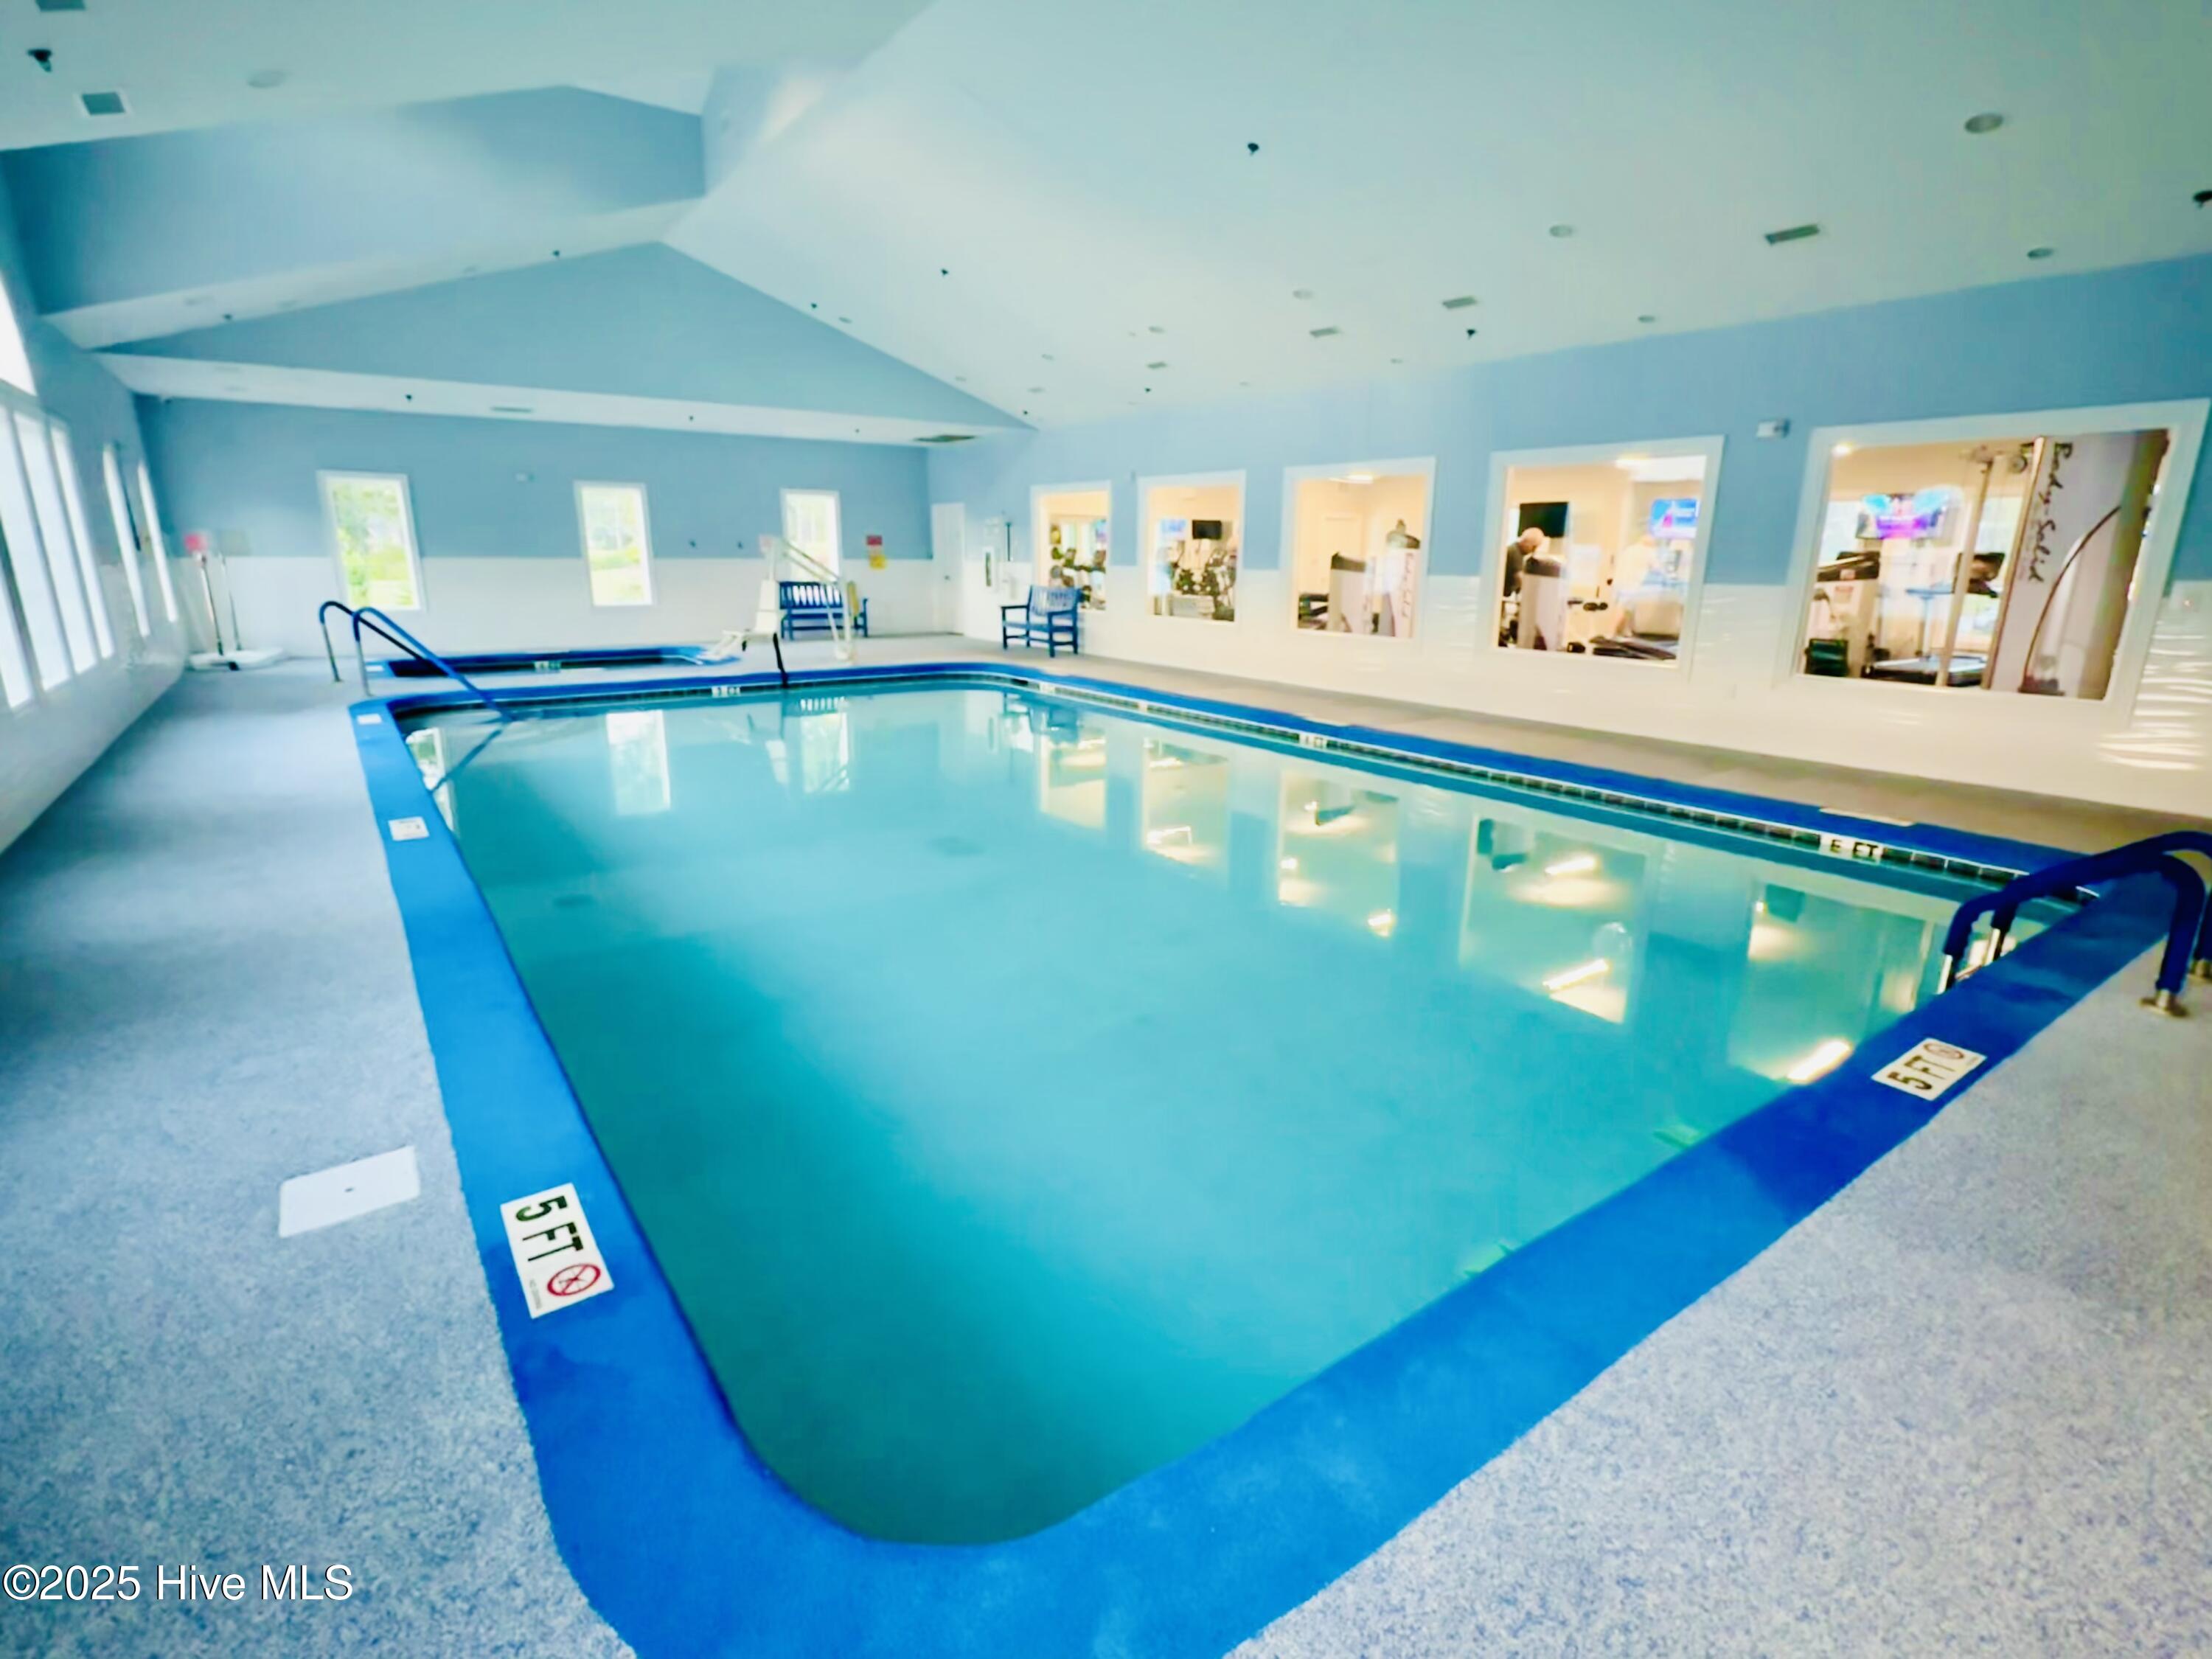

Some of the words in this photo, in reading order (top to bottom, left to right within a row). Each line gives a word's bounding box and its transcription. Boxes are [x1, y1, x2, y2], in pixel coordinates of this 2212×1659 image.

[1888, 1071, 1933, 1090] 5
[1904, 1055, 1955, 1080] FT
[515, 1195, 568, 1222] 5
[522, 1222, 583, 1262] FT
